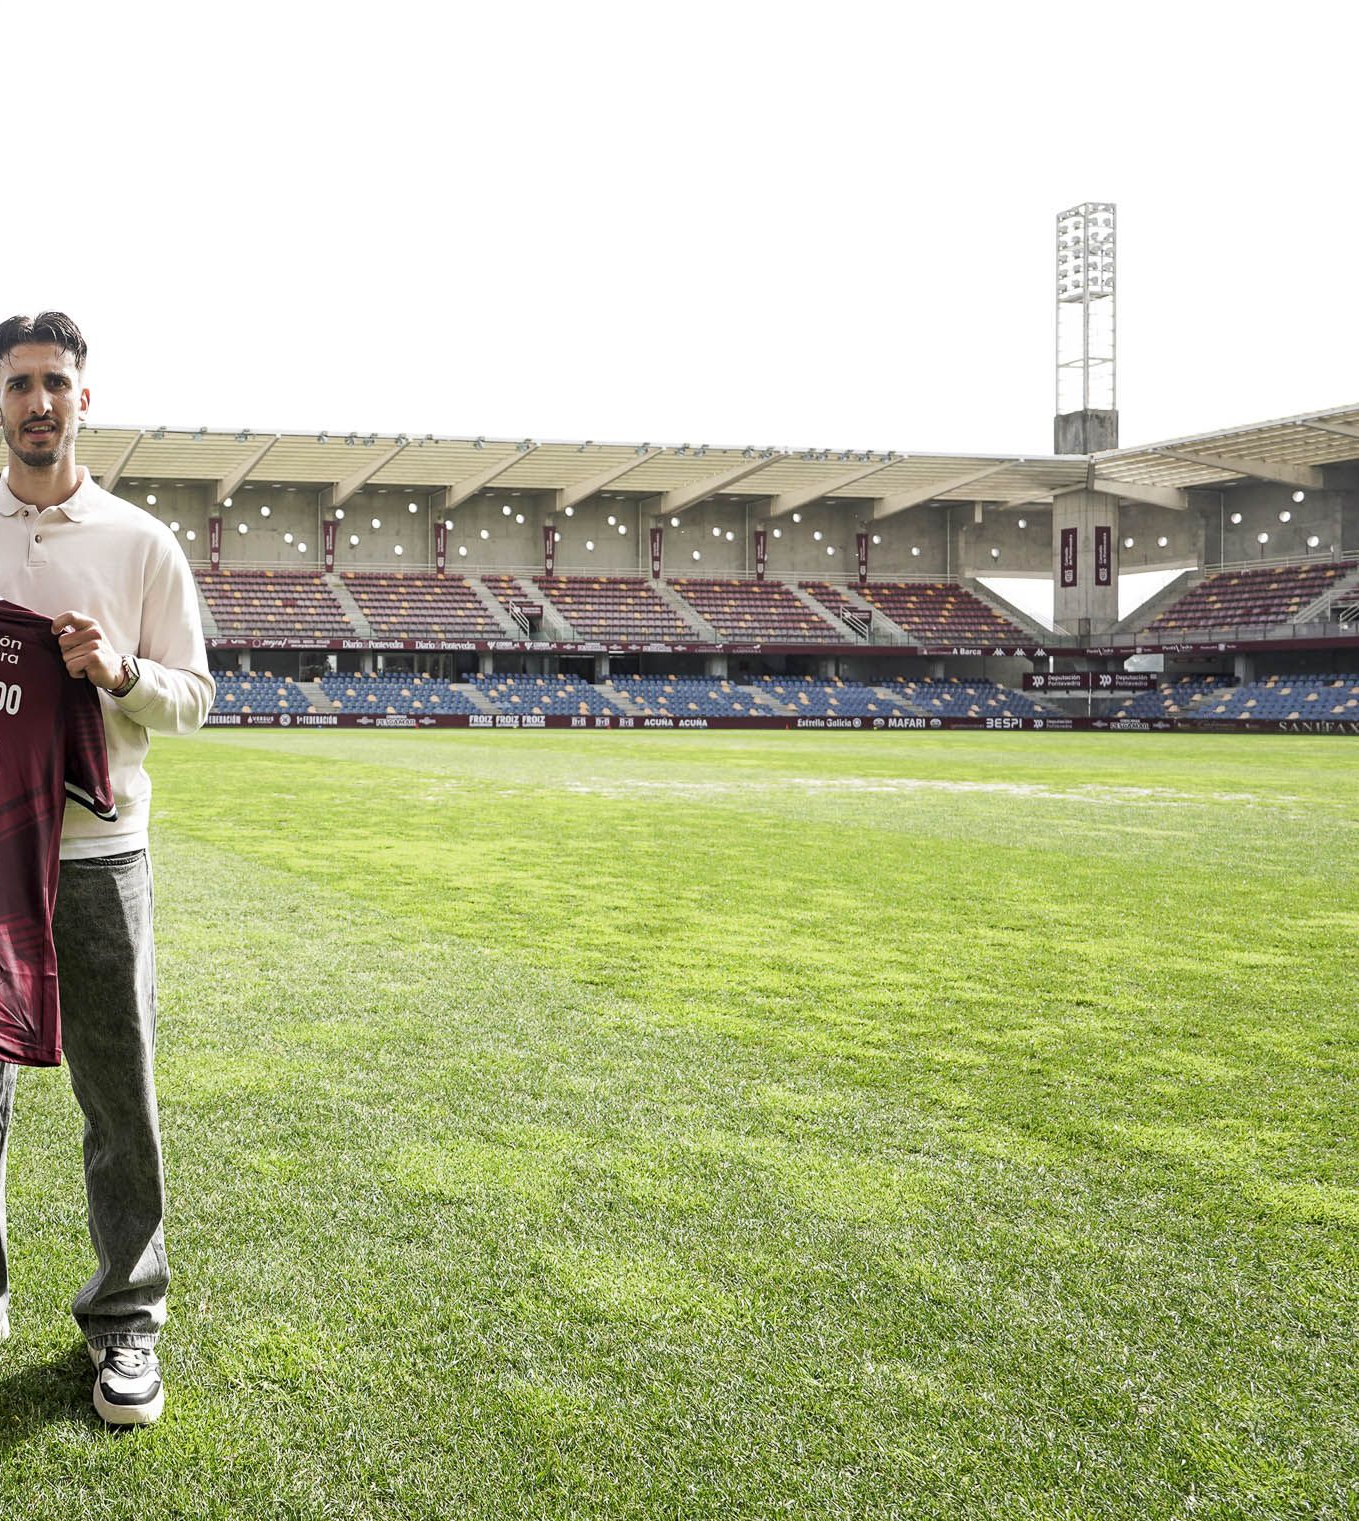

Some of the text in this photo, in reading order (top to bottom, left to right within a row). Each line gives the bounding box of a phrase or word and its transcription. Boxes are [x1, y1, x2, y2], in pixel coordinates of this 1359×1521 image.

[342, 640, 363, 649] Diario
[368, 641, 404, 649] Pontevedra
[415, 641, 436, 649] Diario
[441, 641, 476, 651] Pontevedra
[952, 647, 959, 656] A
[959, 647, 982, 656] Barca
[1047, 674, 1081, 682] Deputación
[1115, 674, 1148, 682] Deputación
[302, 714, 338, 725] FEDERACIÓN
[469, 715, 492, 724] FROIZ
[496, 715, 519, 724] FROIZ
[522, 715, 546, 724] FROIZ
[644, 717, 674, 727] ACUÑA
[678, 718, 708, 727] ACUÑA
[796, 718, 852, 728] Estrella Galicia
[888, 718, 926, 728] MAFARI
